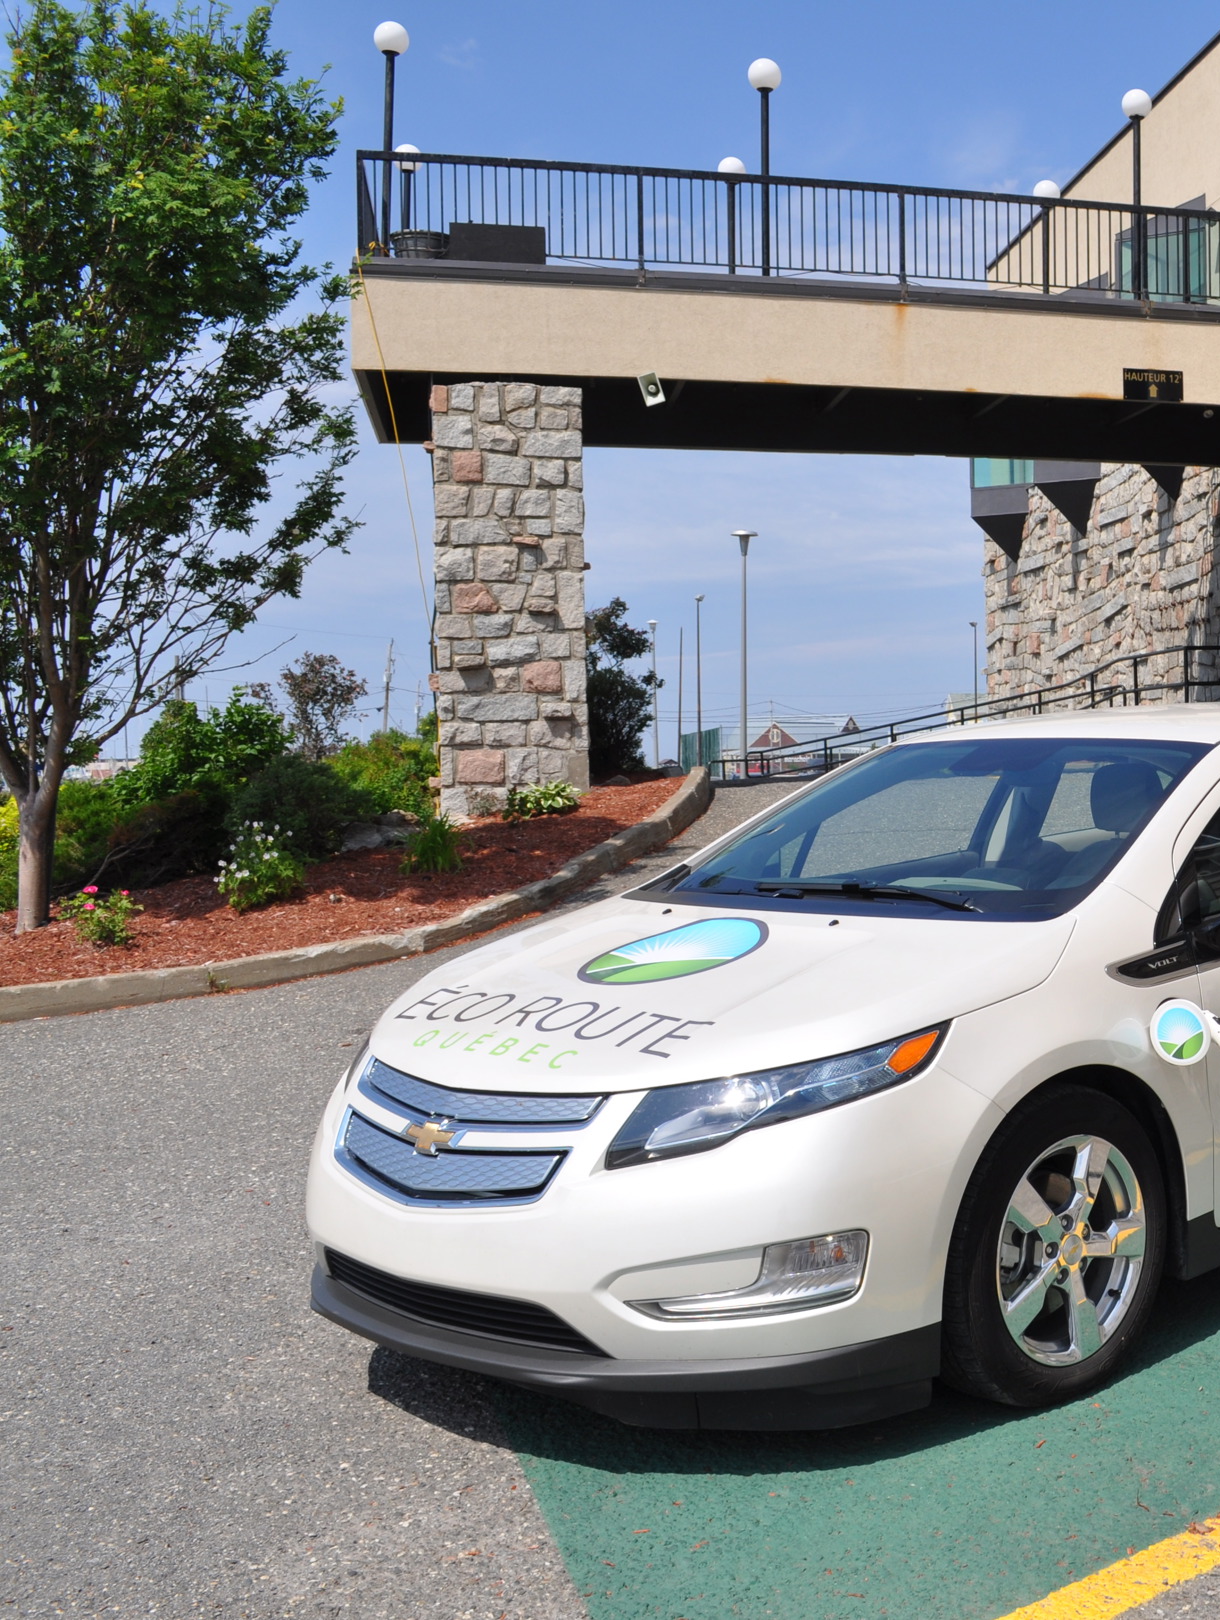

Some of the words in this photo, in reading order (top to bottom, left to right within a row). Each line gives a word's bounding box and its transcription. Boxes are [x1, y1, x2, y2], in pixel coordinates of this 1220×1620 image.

[1124, 371, 1167, 383] HAUTEUR
[1147, 955, 1178, 970] VOLT
[394, 985, 516, 1022] ÉCO
[493, 996, 716, 1059] ROUTE
[413, 1029, 579, 1069] QUÉBEC
